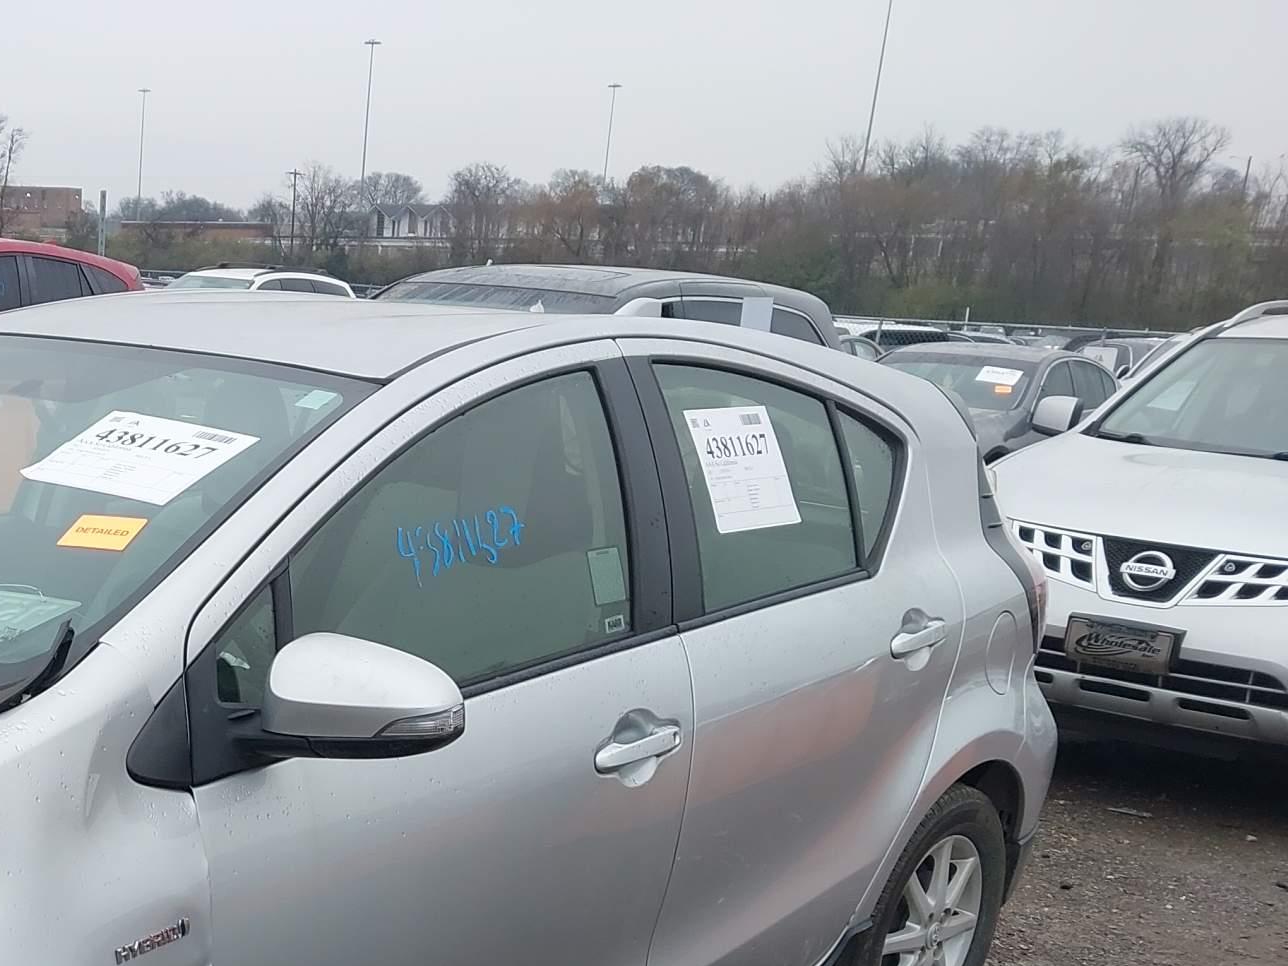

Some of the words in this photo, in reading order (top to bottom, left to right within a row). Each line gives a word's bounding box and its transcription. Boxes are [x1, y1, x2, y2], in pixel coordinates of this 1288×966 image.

[96, 428, 218, 459] 43811627
[706, 433, 769, 459] 43811627
[75, 526, 130, 537] DETAILED
[1125, 565, 1168, 576] NISSAN
[1087, 632, 1161, 655] Wholesale
